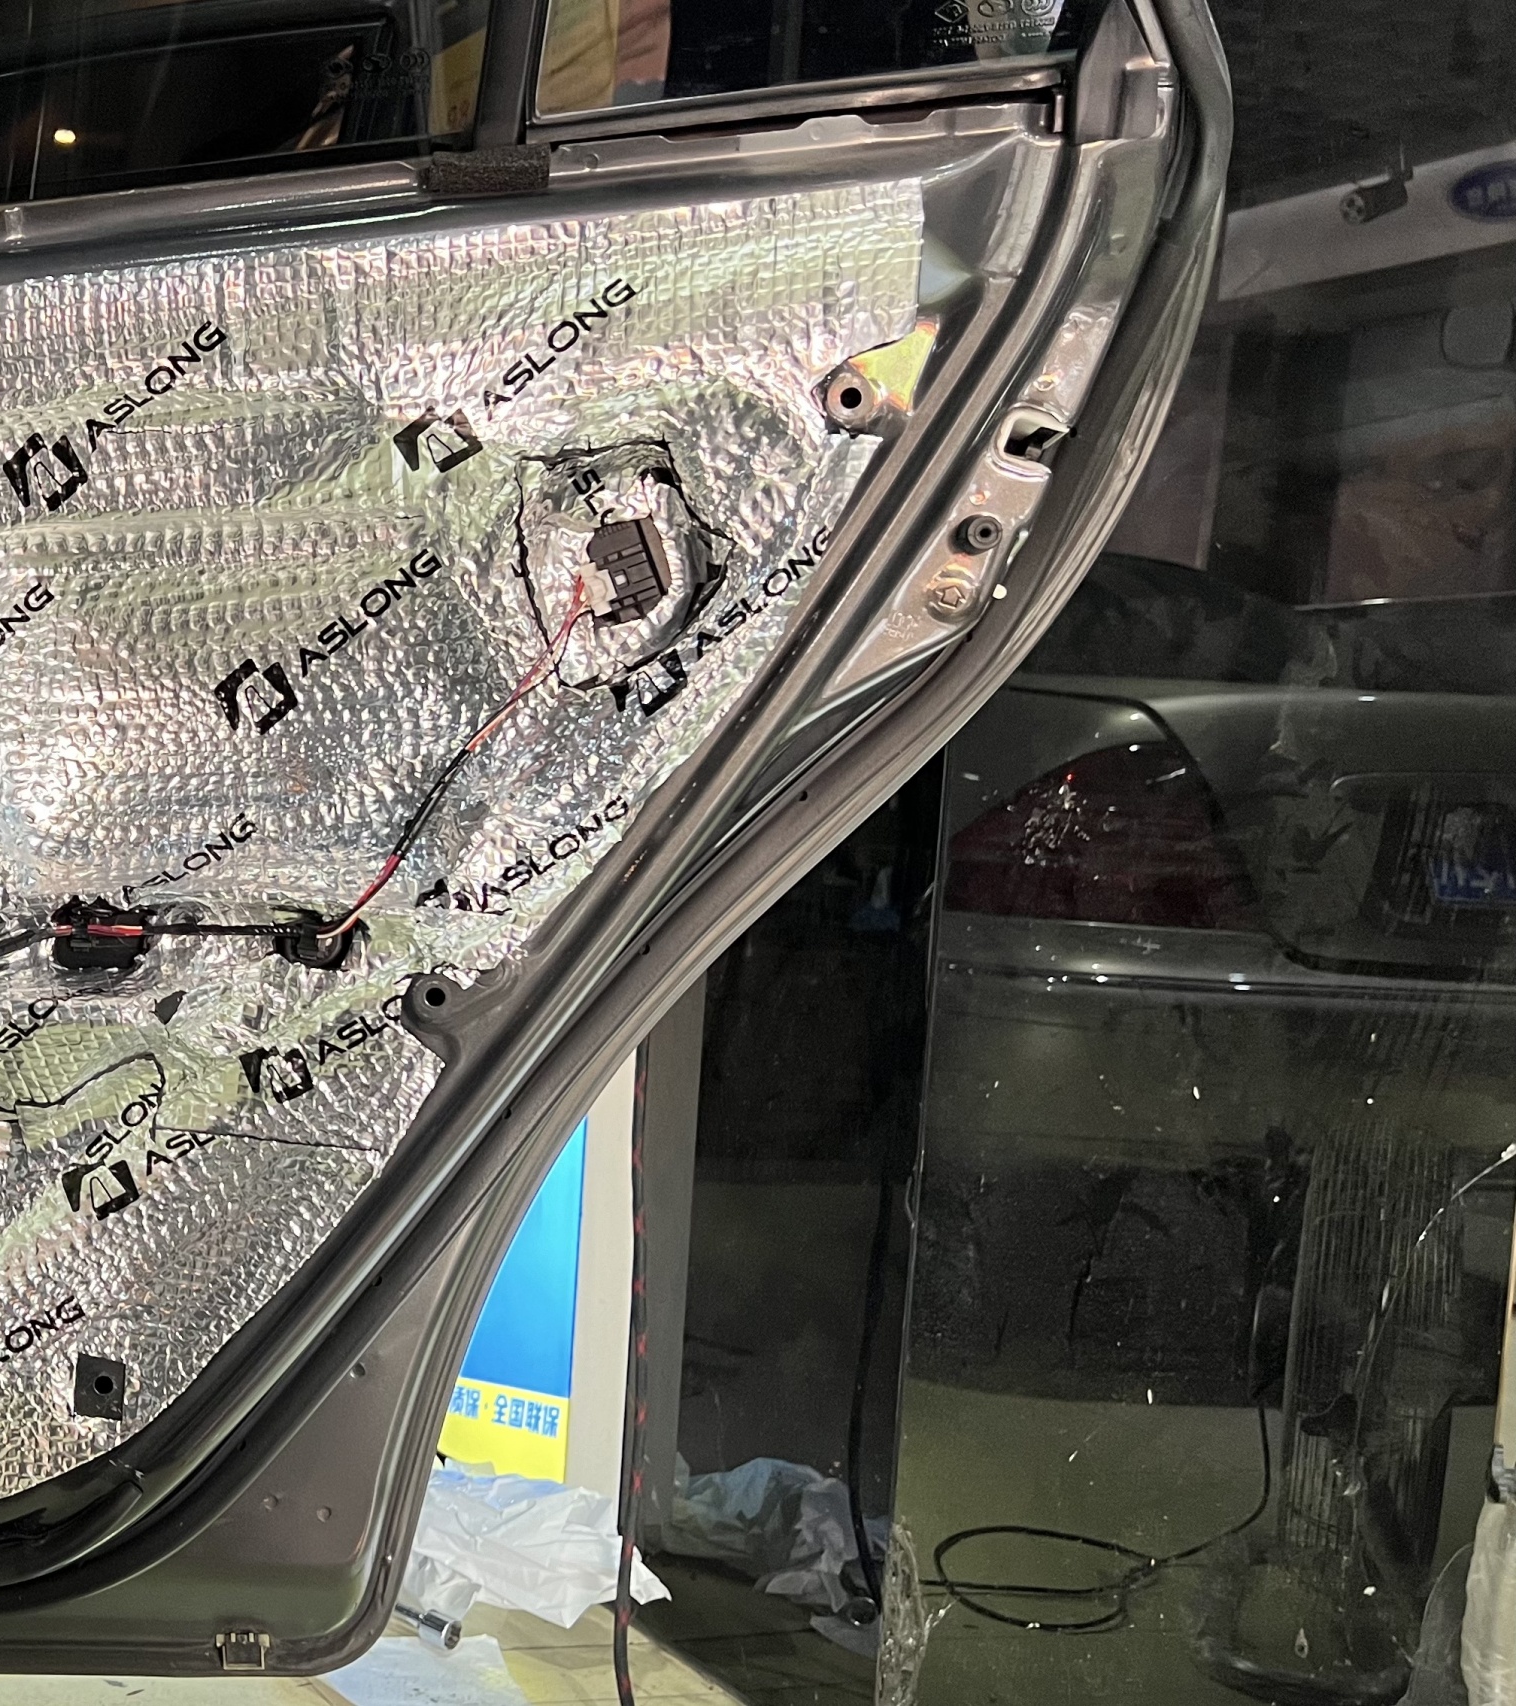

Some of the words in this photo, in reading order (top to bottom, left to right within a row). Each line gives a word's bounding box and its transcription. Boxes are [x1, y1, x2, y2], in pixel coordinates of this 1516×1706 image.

[88, 320, 226, 452] ASLONG
[484, 277, 636, 422] ASLONG
[299, 548, 442, 676] ASLONG
[697, 526, 832, 658] ASLONG
[482, 795, 629, 912] ASLONG
